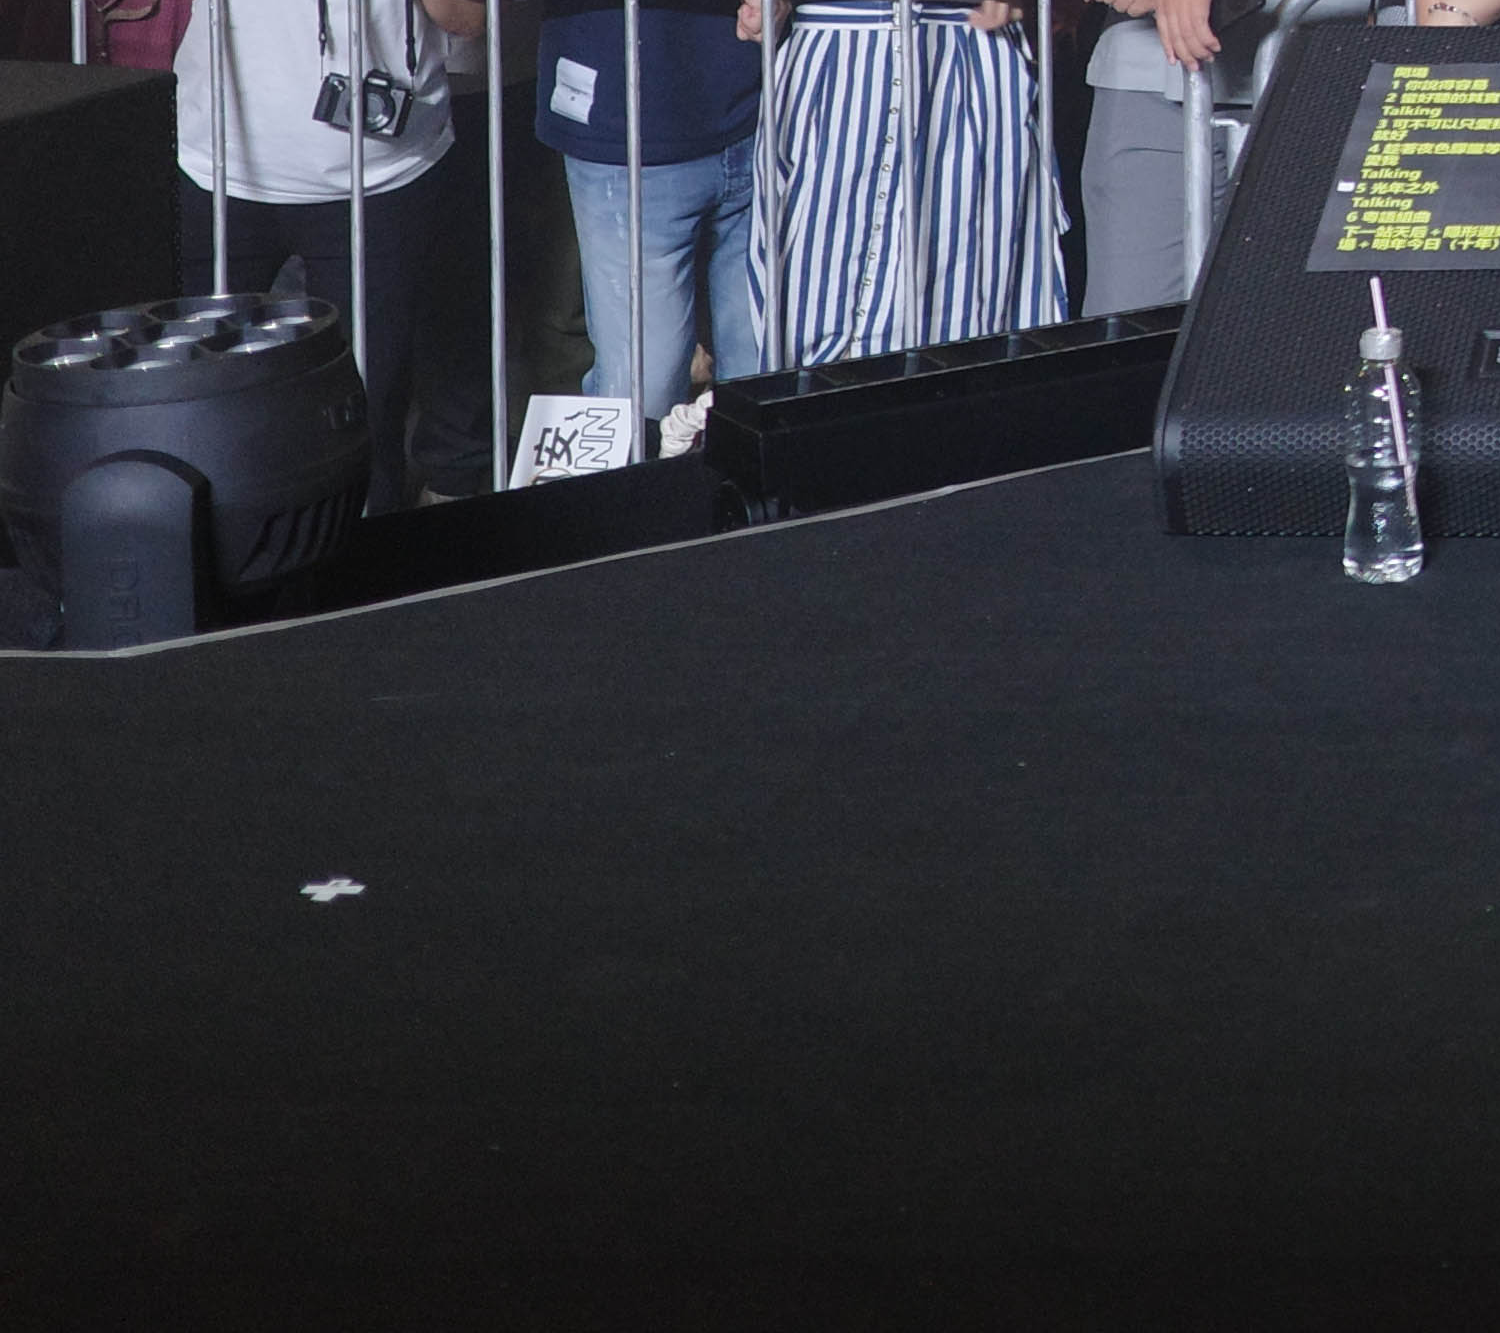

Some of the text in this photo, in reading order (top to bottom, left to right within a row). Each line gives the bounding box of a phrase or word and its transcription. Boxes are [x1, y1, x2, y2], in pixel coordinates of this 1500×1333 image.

[1382, 106, 1443, 118] Talking
[1361, 168, 1422, 181] Talking
[1370, 181, 1440, 194] 光年之外
[1352, 196, 1413, 209] Talking
